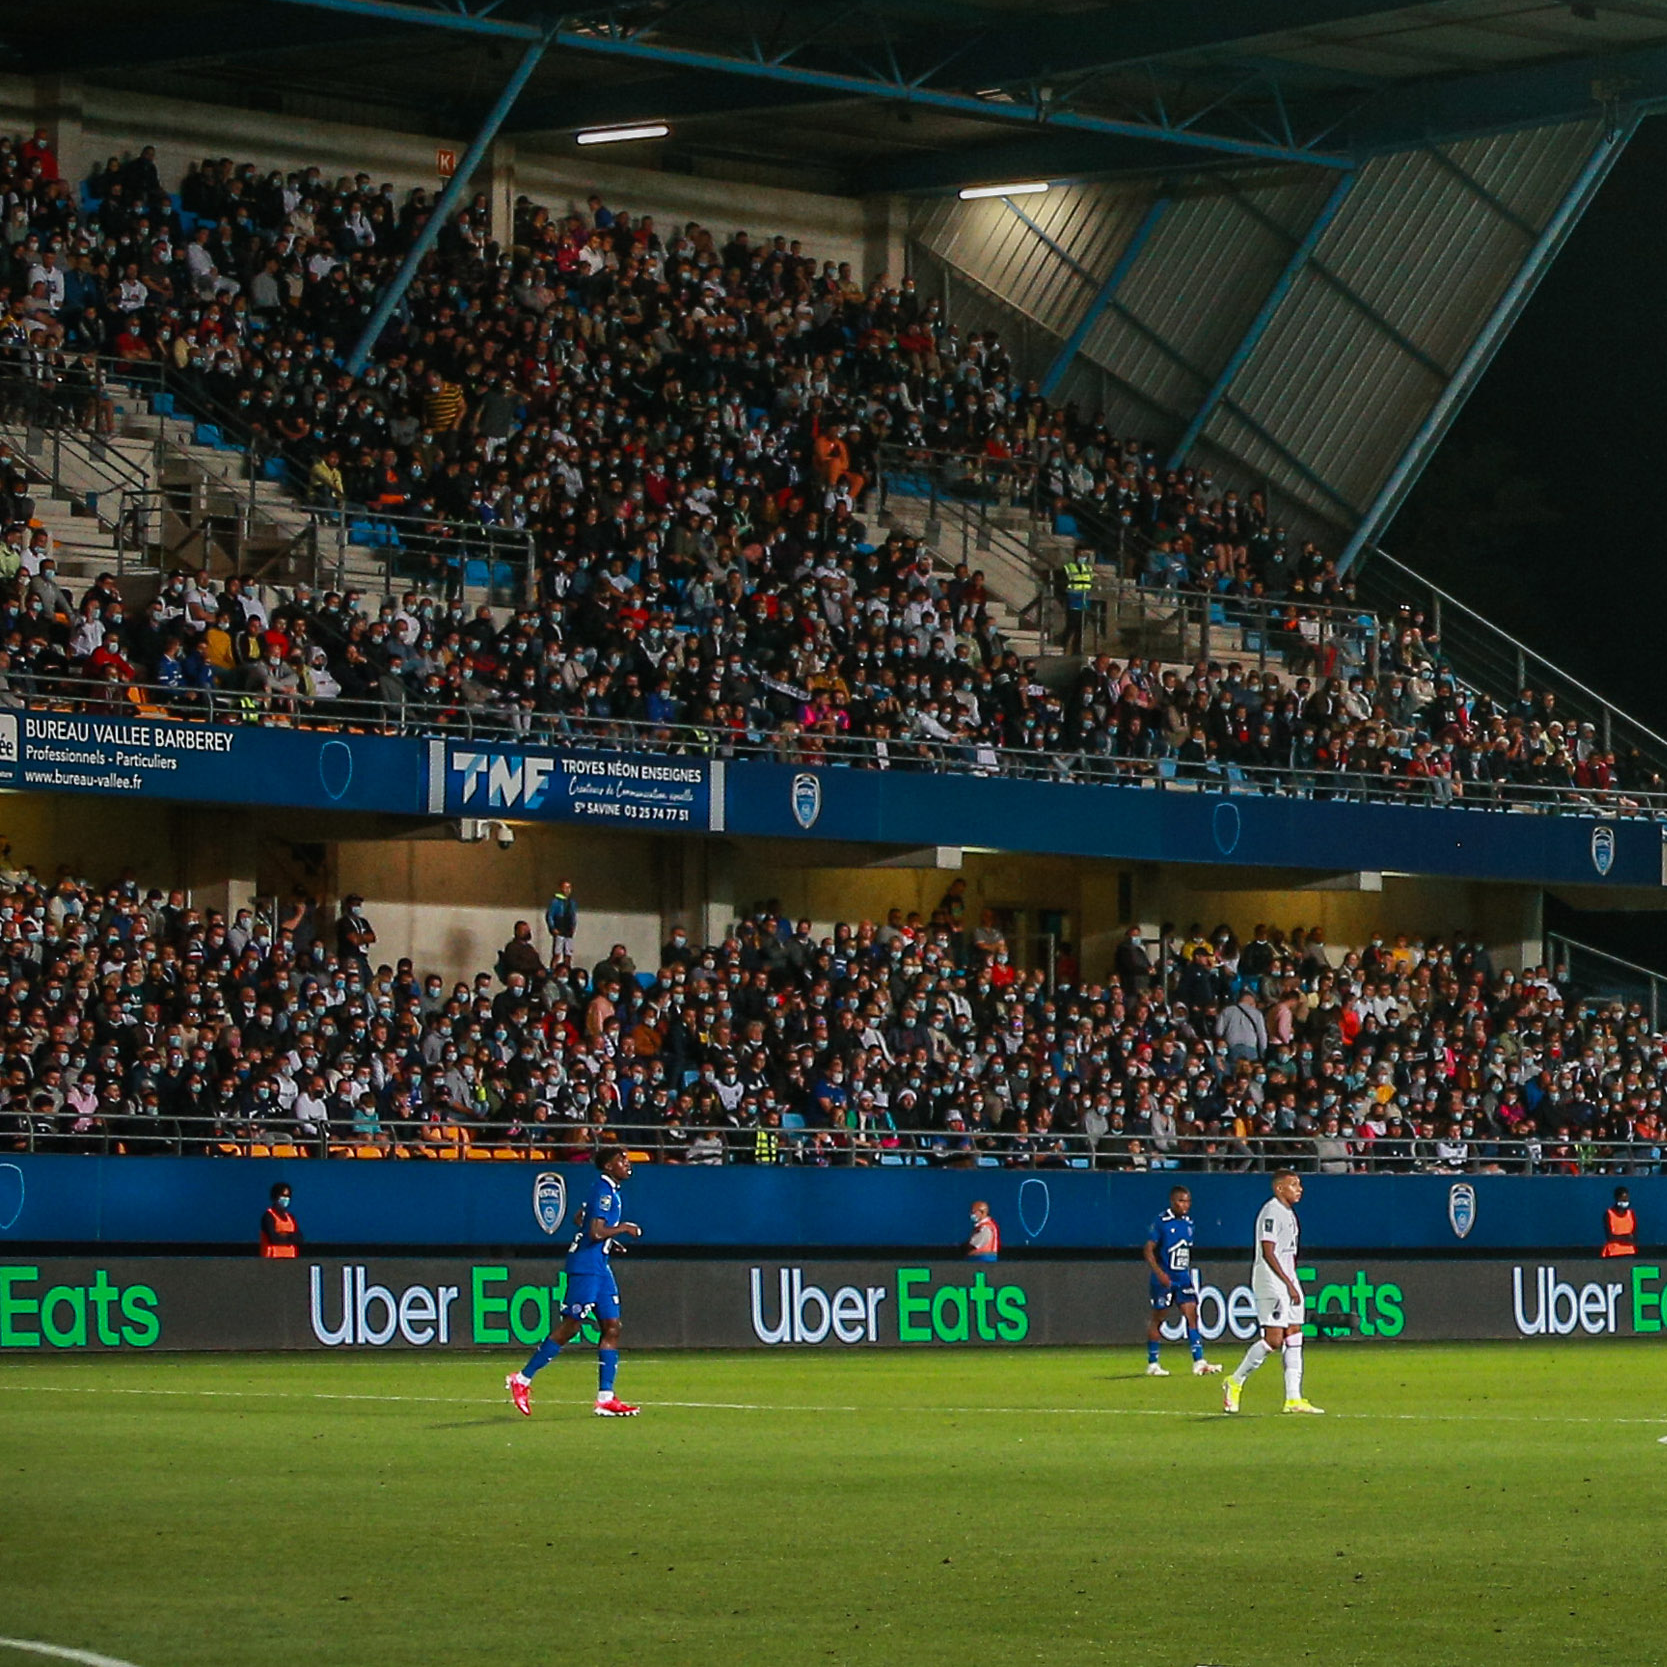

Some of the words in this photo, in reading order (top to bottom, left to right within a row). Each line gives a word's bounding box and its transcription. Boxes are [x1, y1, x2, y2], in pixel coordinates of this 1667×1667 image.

[441, 154, 451, 170] K
[25, 718, 89, 742] BUREAU
[93, 724, 150, 747] VALLEE
[155, 729, 234, 752] BARBEREY
[26, 745, 105, 766] Professionnels
[116, 751, 178, 770] Particuliers
[561, 759, 605, 775] TROYES
[608, 760, 639, 779] NÉON
[641, 766, 701, 783] ENSEIGNES
[25, 769, 142, 790] www.bureau-vallee.fr
[587, 803, 621, 816] SAVINE
[624, 806, 637, 818] 03
[639, 807, 650, 819] 25
[652, 808, 664, 820] 74
[666, 808, 677, 821] 77
[0, 1265, 160, 1348] Eats
[309, 1264, 459, 1347] Uber
[750, 1267, 886, 1344] Uber
[899, 1267, 1029, 1342] Eats
[1512, 1265, 1623, 1335] Uber
